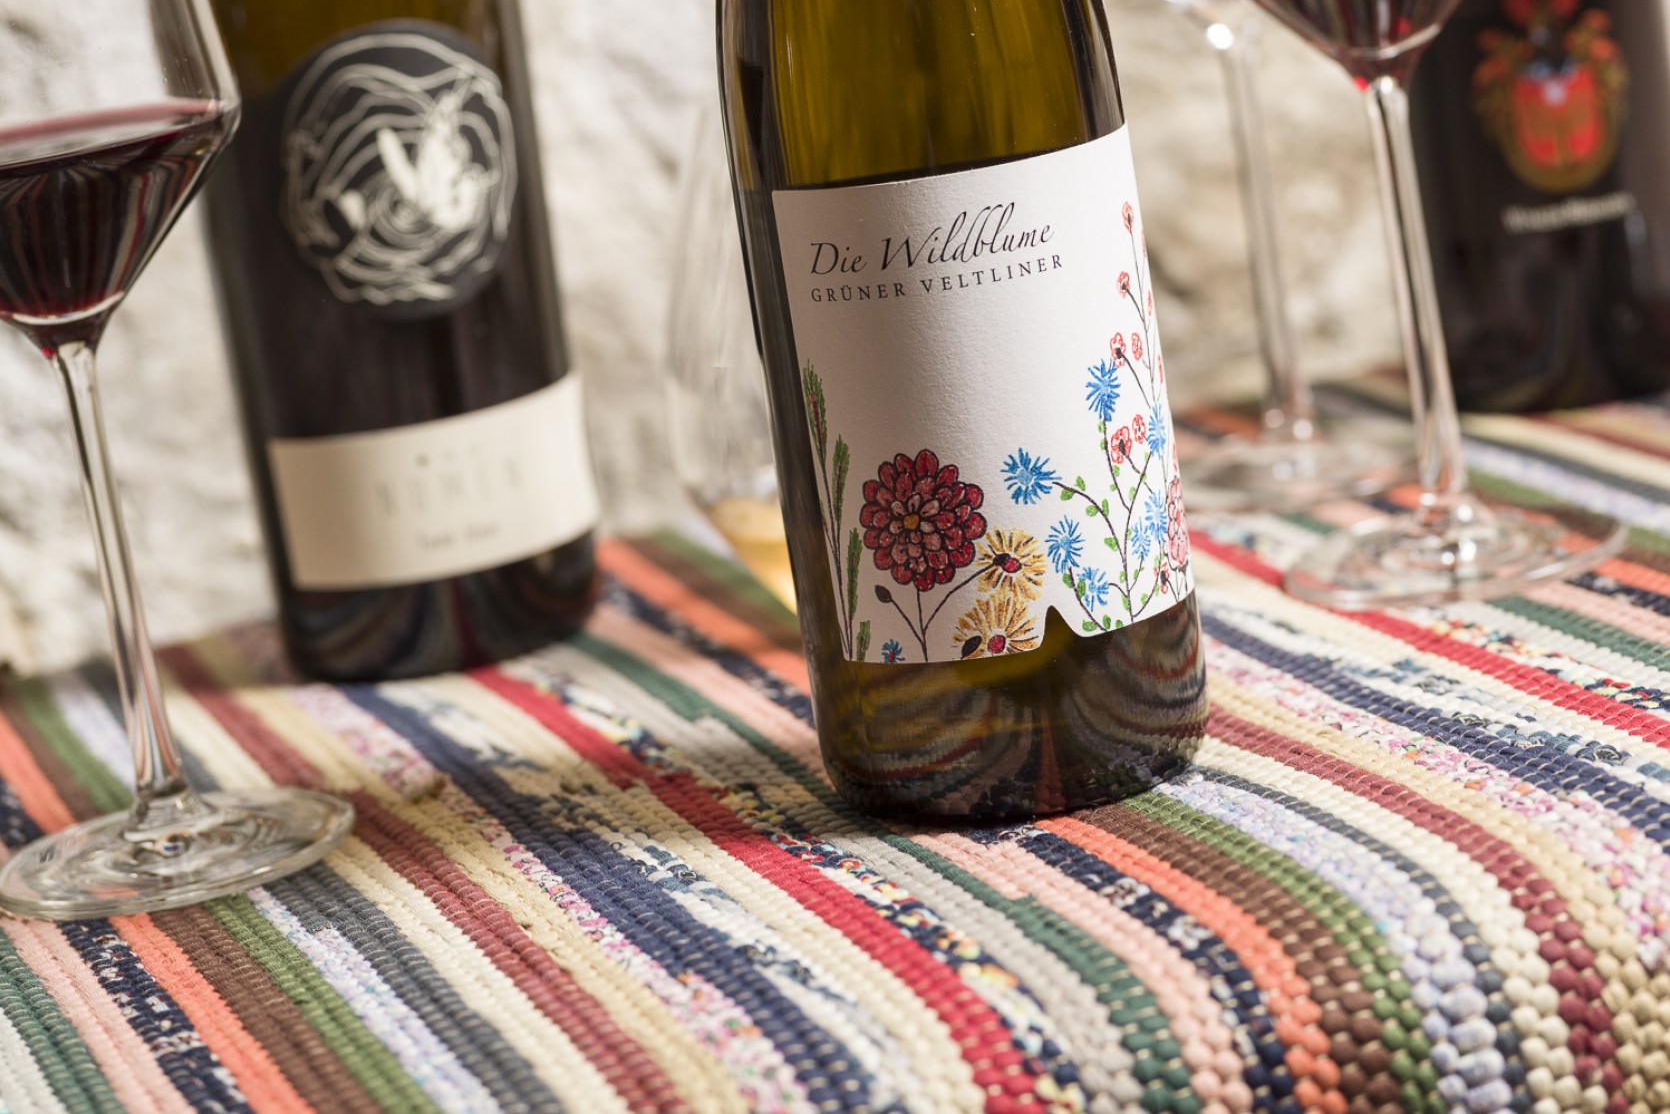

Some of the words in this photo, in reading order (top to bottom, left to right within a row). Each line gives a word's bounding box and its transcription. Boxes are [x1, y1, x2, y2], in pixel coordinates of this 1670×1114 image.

[881, 201, 1055, 271] Wildblume
[810, 242, 867, 275] Die
[920, 254, 1063, 293] VELTLINER
[811, 282, 906, 303] GRÜNER
